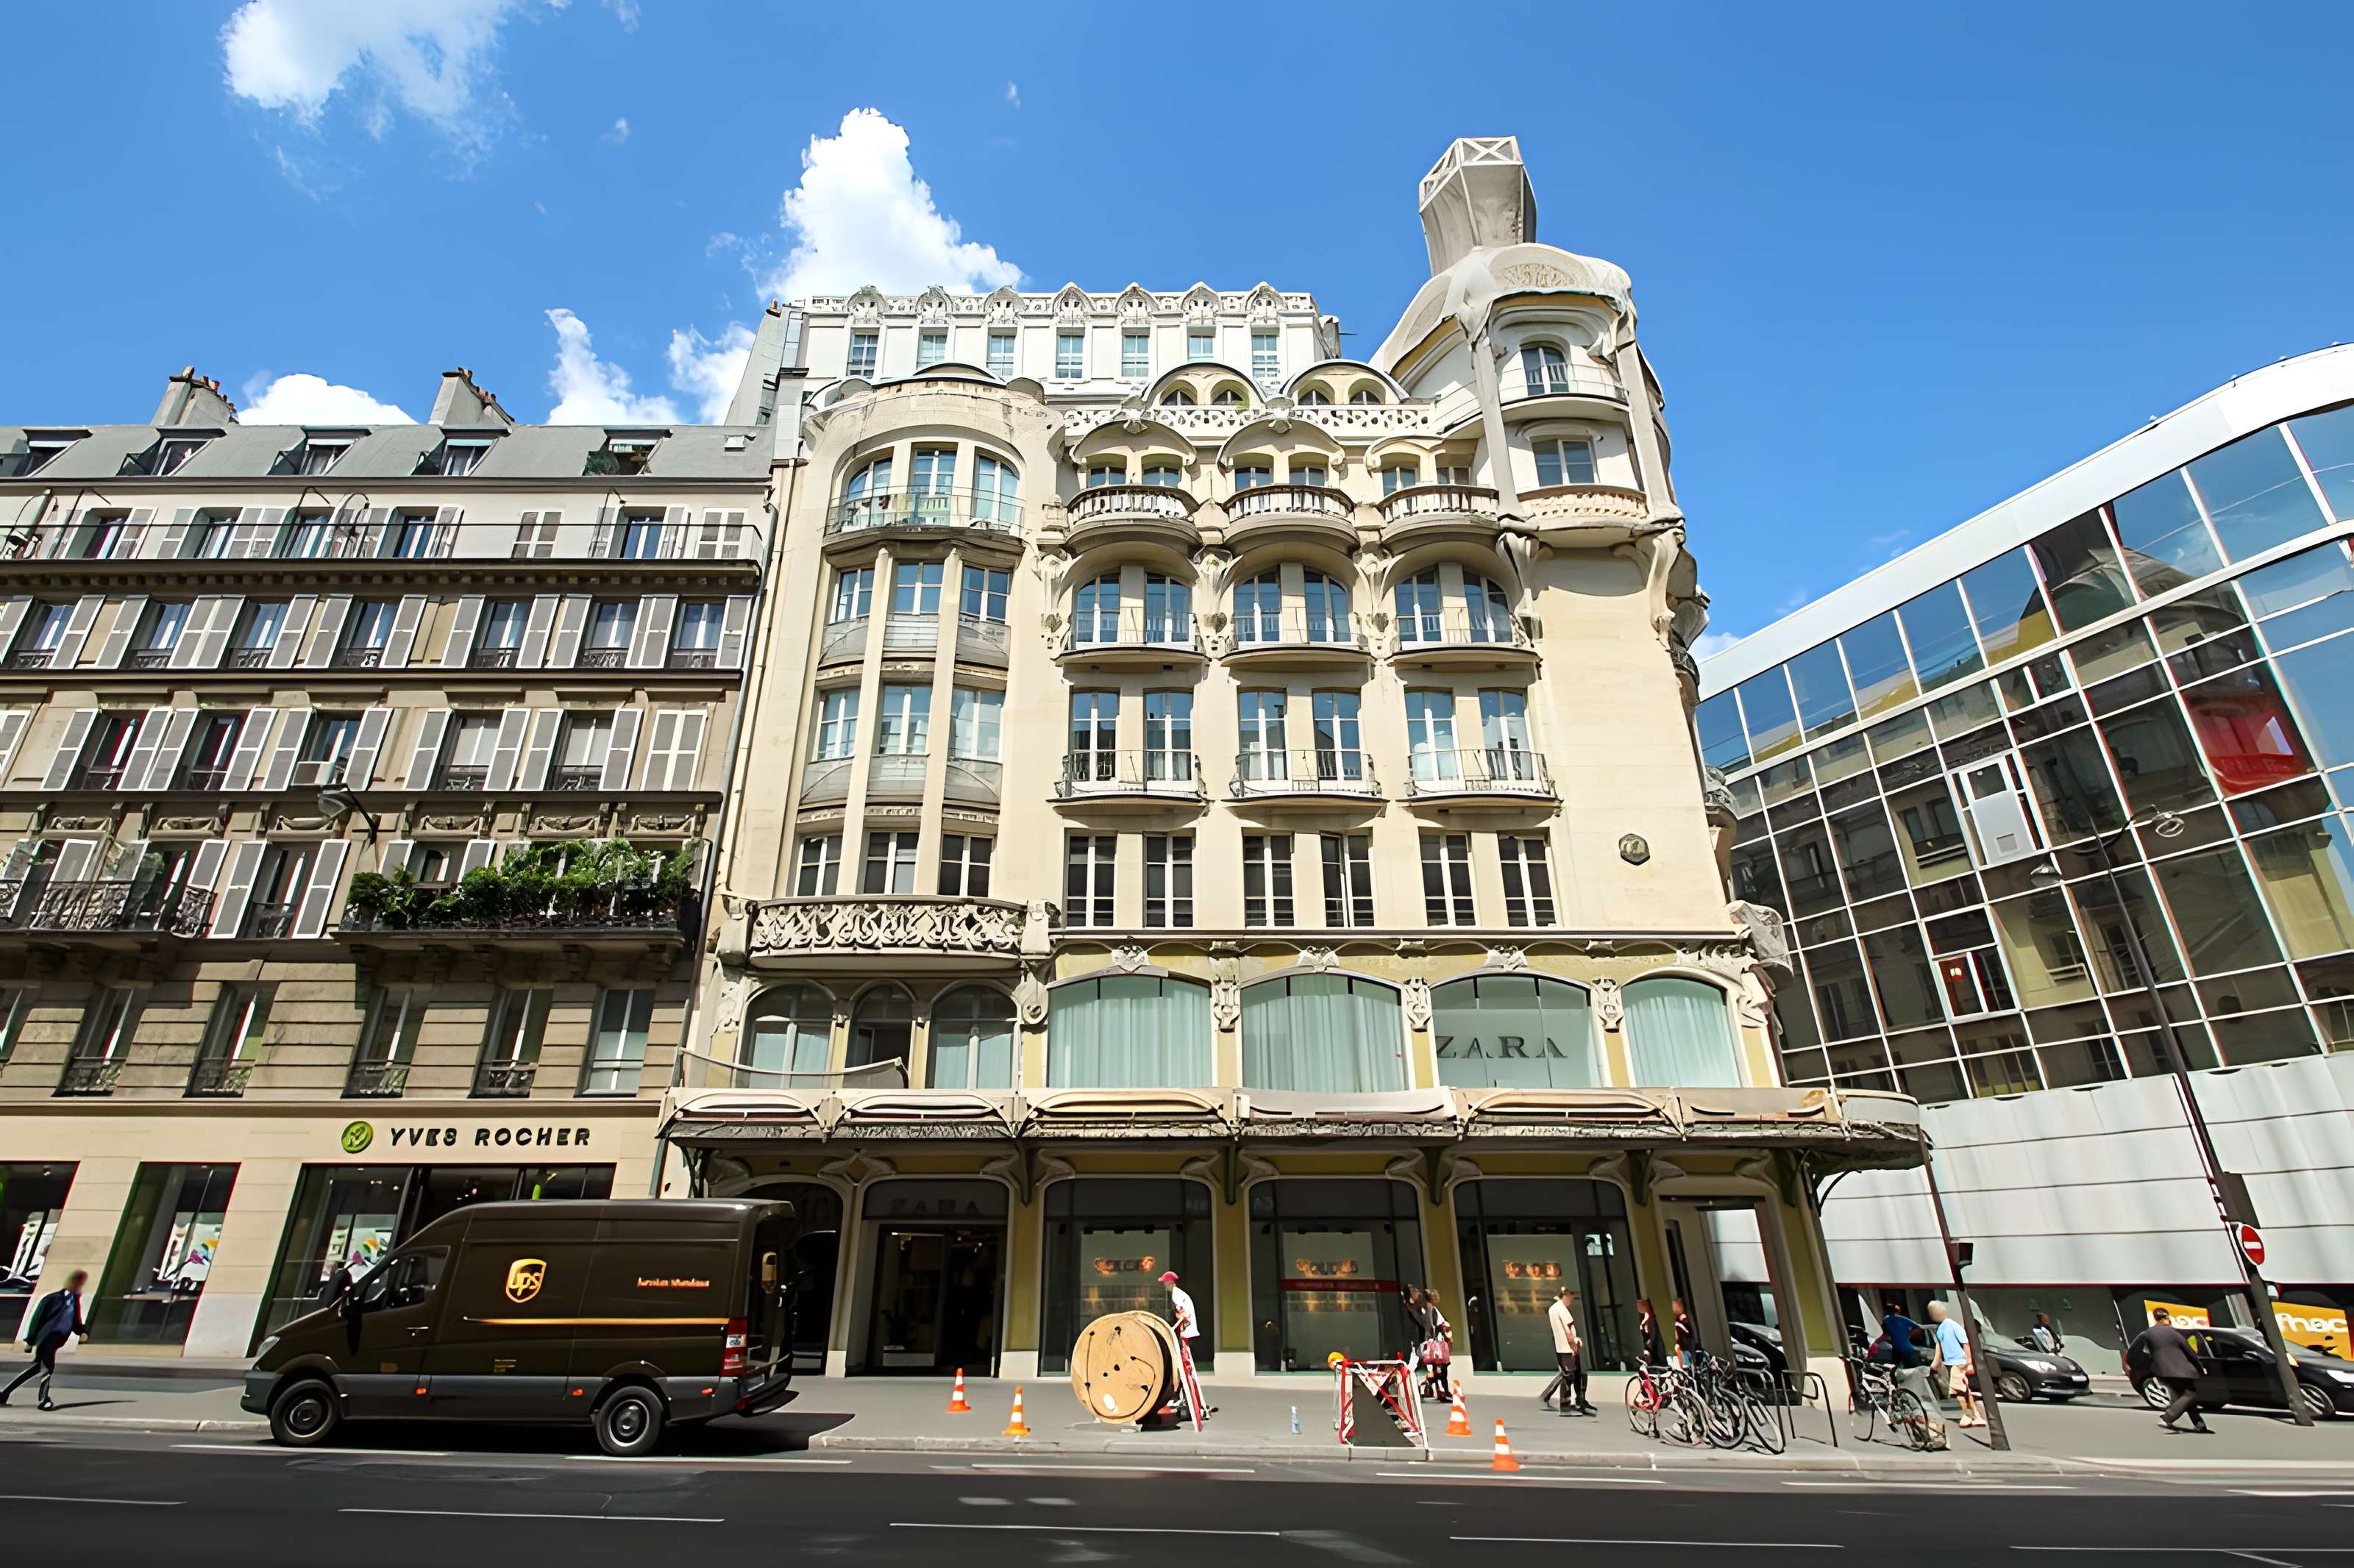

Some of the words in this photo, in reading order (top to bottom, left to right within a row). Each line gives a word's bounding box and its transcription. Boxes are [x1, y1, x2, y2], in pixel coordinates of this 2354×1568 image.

[1435, 1036, 1568, 1058] ZARA
[391, 1127, 458, 1147] YVES
[474, 1127, 590, 1147] ROCHER
